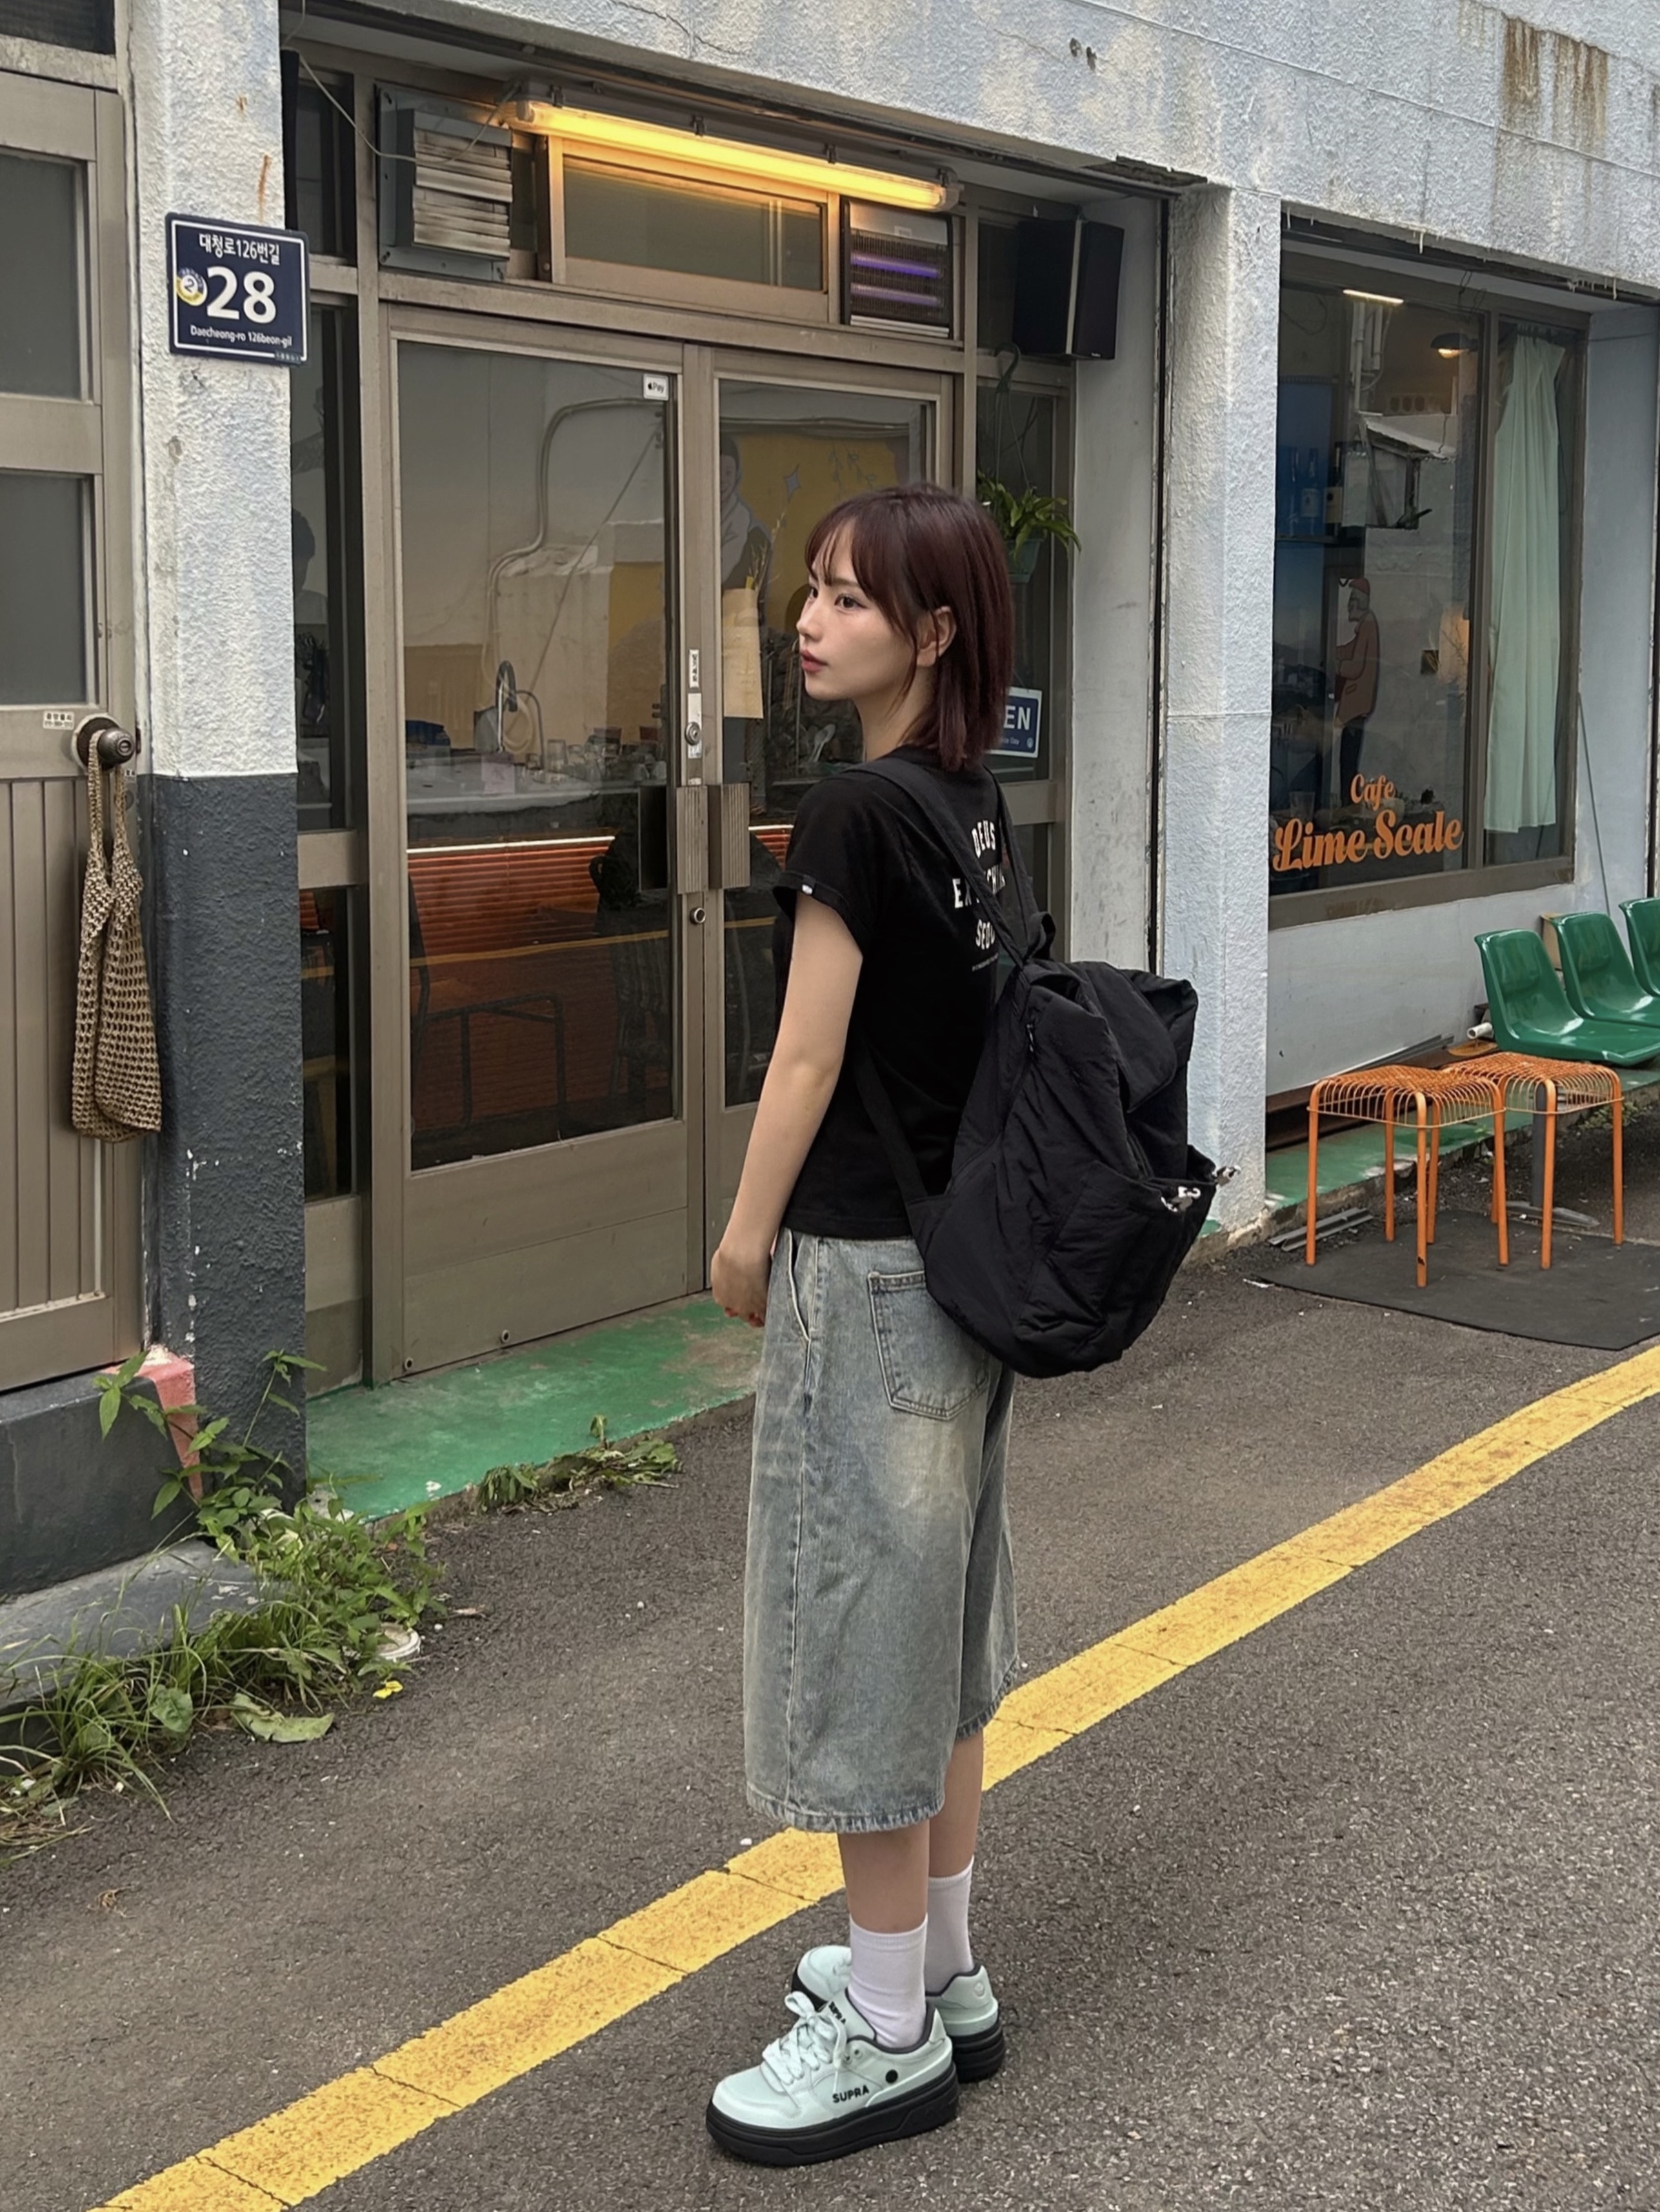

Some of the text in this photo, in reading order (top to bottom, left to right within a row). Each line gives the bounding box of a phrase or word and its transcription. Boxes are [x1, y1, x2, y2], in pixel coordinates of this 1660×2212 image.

[199, 233, 280, 266] 대청로126번길
[206, 265, 277, 324] 28
[190, 324, 292, 348] Daecheong-ro 126beon-gil
[652, 381, 665, 394] Pay
[1003, 705, 1031, 731] EN
[1350, 773, 1396, 811] Cafe
[971, 820, 996, 858] DEUS
[1272, 809, 1465, 872] Lime Scale
[975, 919, 995, 950] SEOU
[832, 2084, 870, 2103] SUPRA
